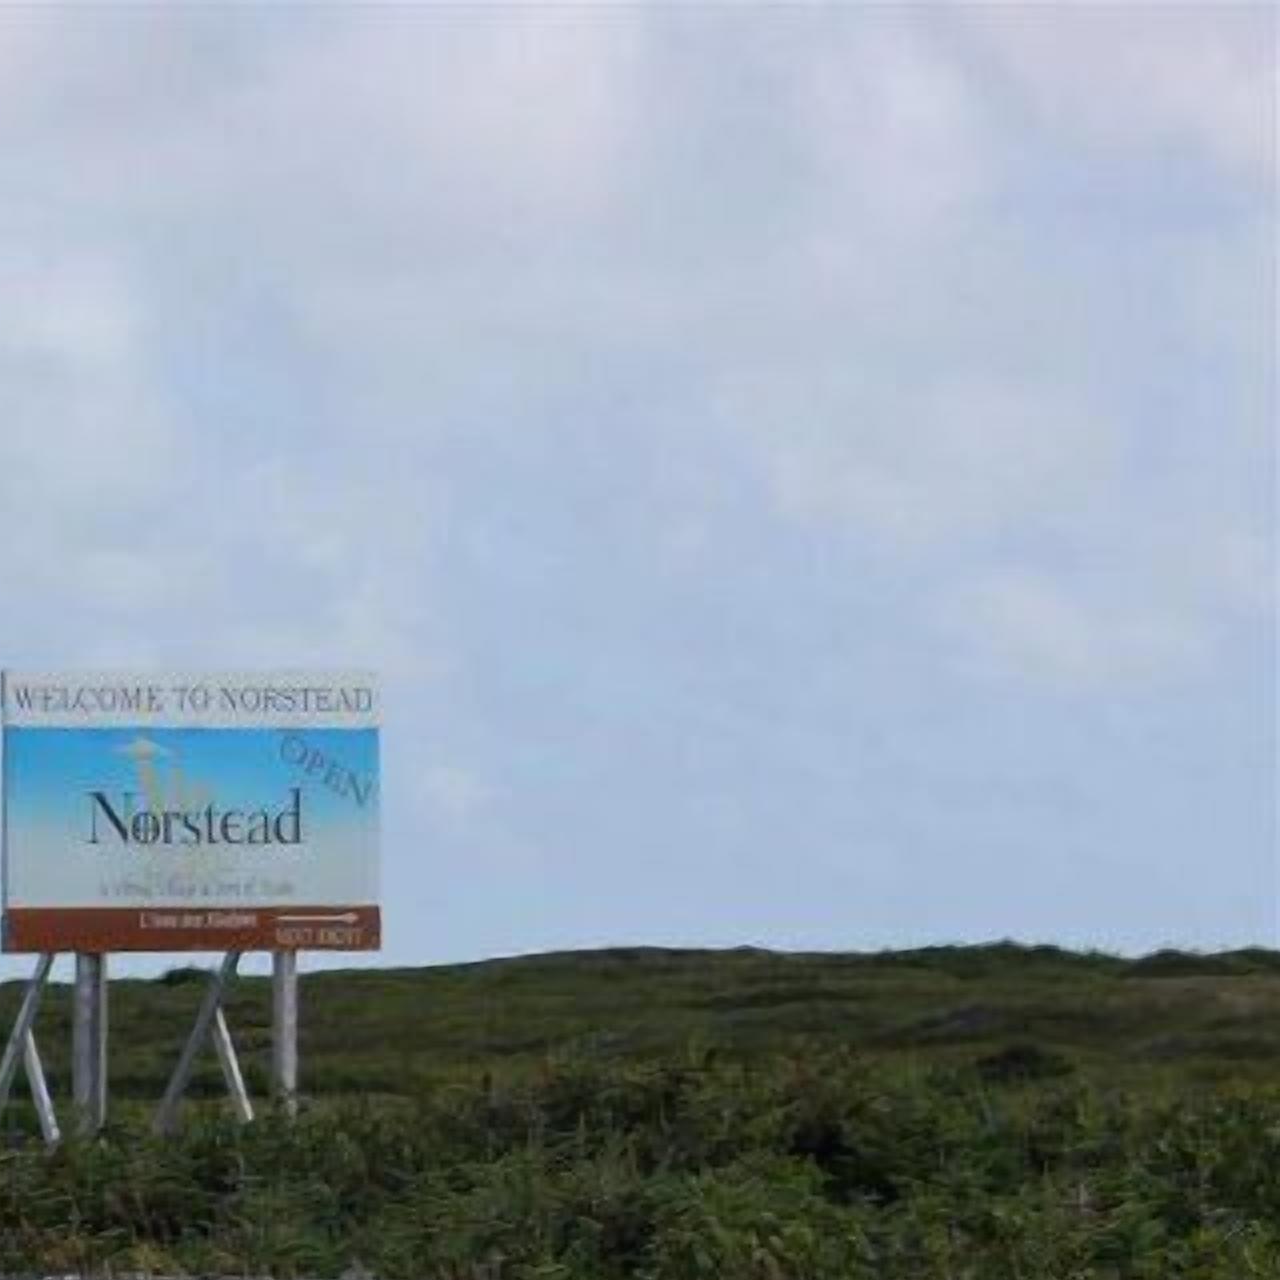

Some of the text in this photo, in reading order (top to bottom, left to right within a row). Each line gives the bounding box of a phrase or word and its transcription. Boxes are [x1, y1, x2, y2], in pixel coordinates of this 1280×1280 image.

[16, 685, 373, 714] WELCOME TO NORSTEAD
[279, 735, 374, 808] OPEN
[88, 787, 302, 845] Norstead
